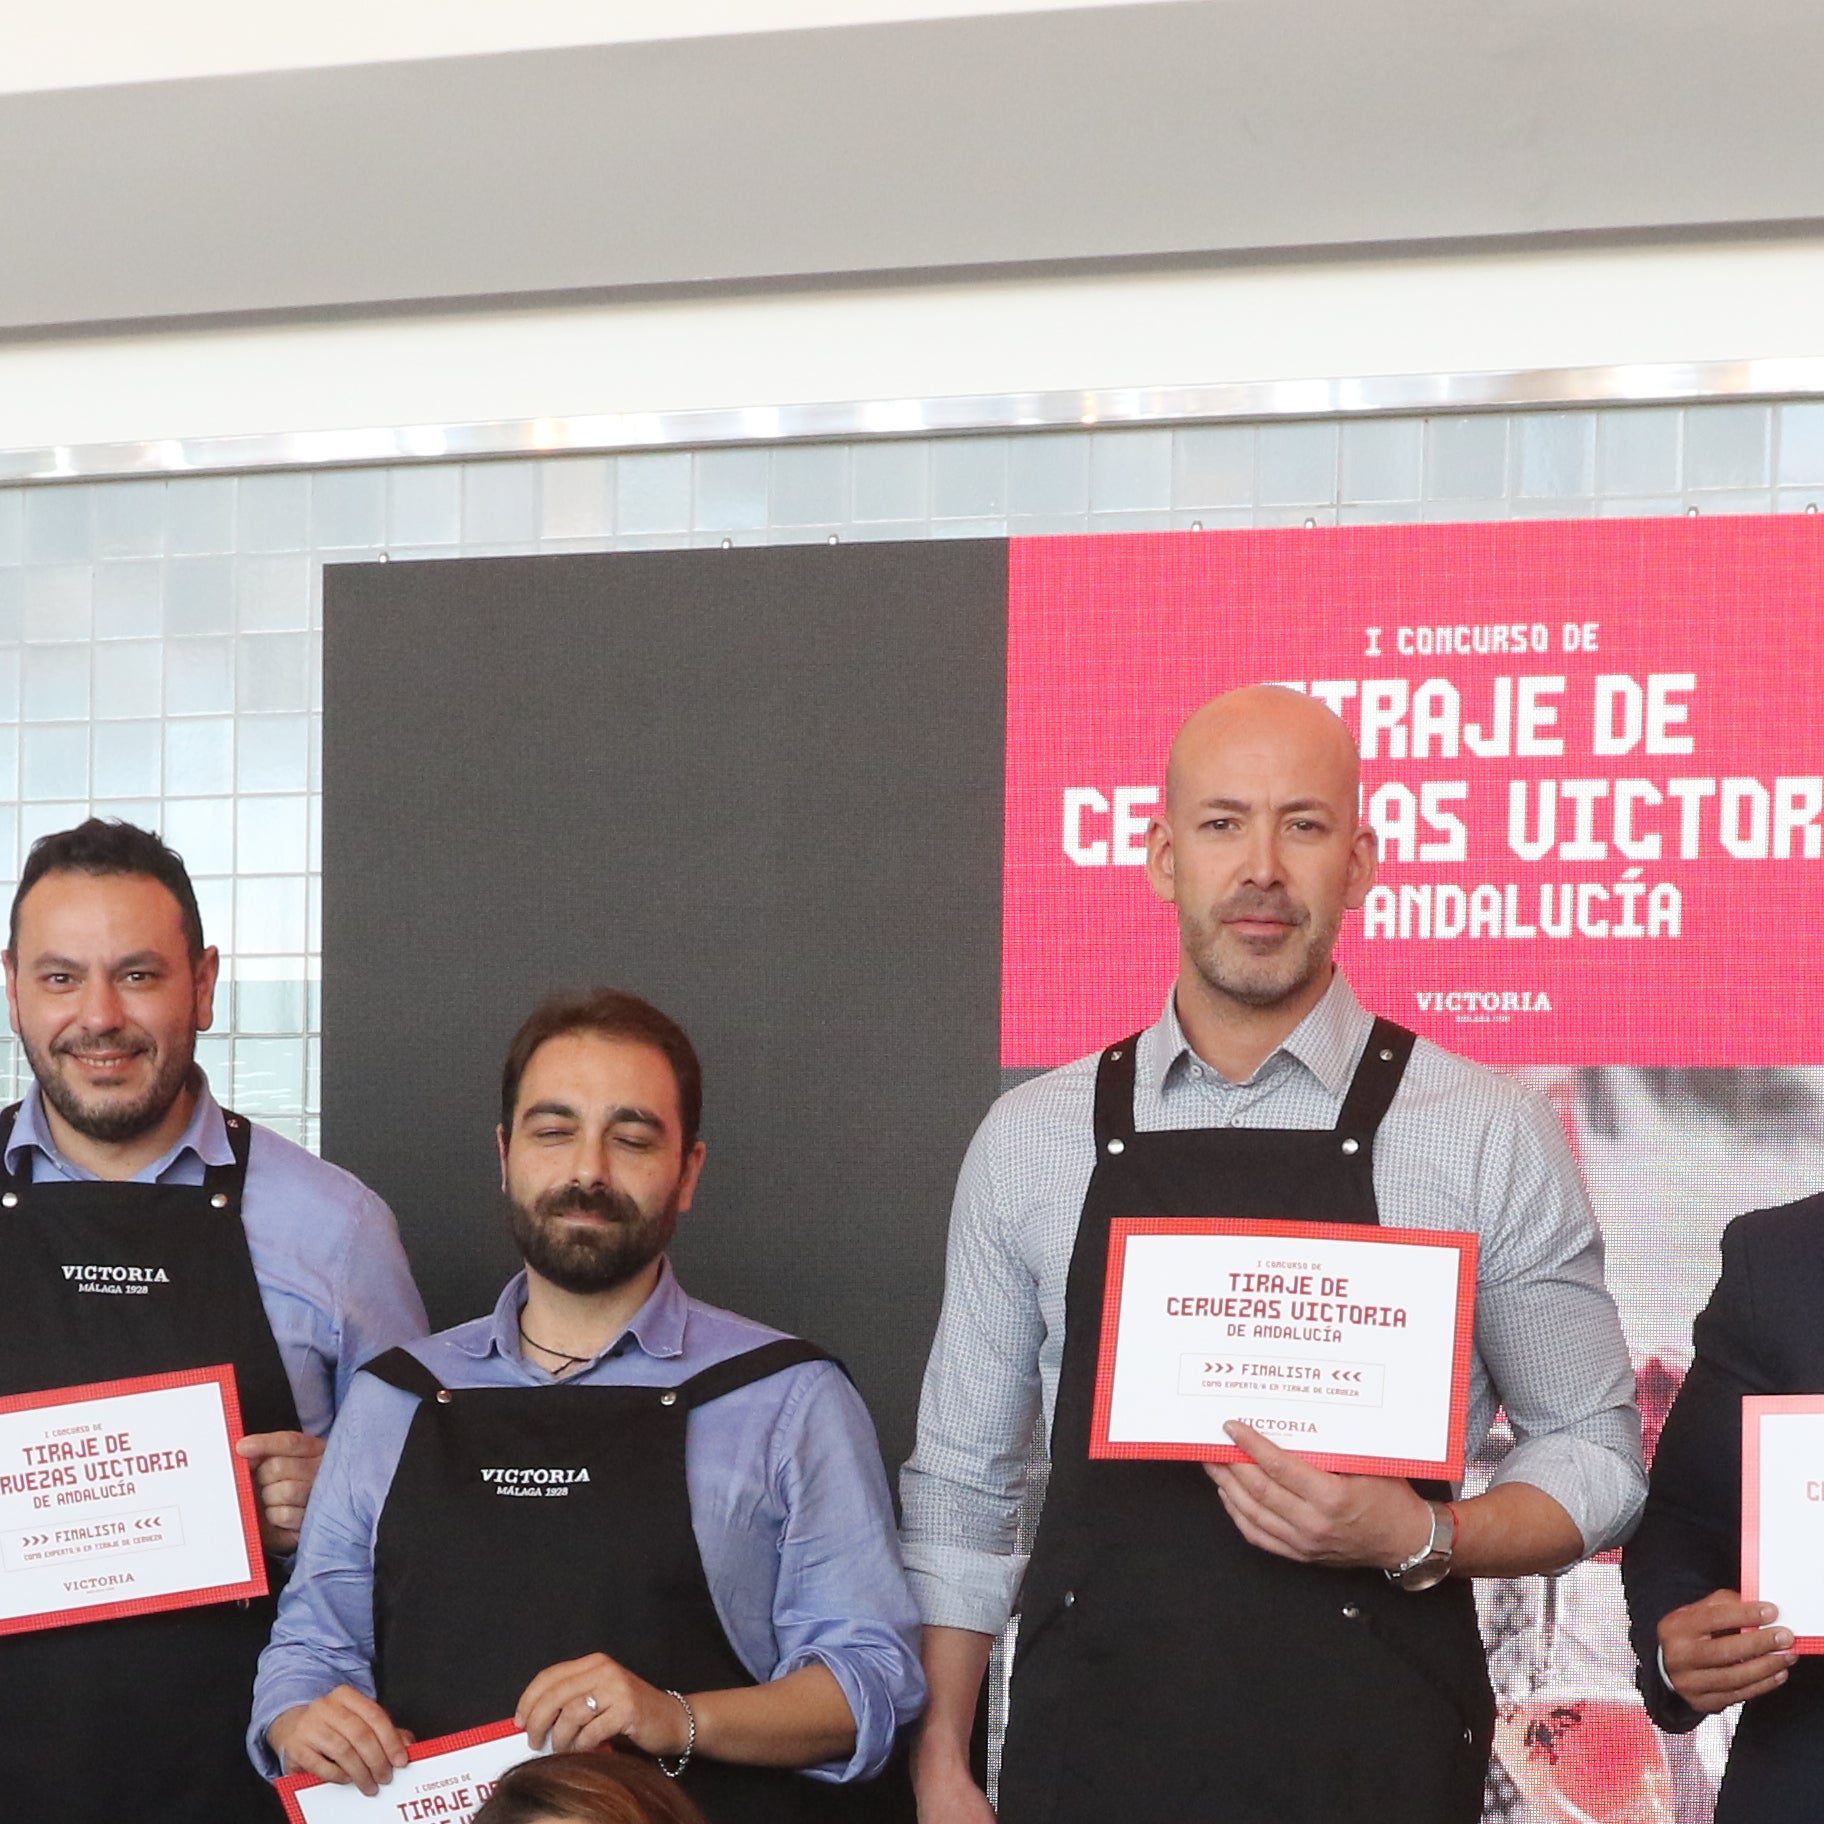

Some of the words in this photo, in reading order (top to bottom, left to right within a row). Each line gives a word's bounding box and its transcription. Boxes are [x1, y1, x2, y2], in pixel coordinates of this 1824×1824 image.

[1366, 628, 1381, 656] I
[1397, 625, 1548, 655] CONCURSO
[1561, 623, 1599, 653] DE
[1259, 675, 1564, 760] RAJE
[1594, 673, 1695, 756] DE
[1364, 867, 1681, 940] ANDALUCÍA
[1416, 992, 1553, 1011] VICTORIA
[61, 1266, 169, 1283] VICTORIA
[1227, 1272, 1313, 1295] TIRAJE
[1320, 1277, 1349, 1297] DE
[79, 1282, 122, 1294] MÁLAGA
[125, 1285, 148, 1294] 1928
[1166, 1295, 1281, 1319] CERVEZAS
[1290, 1301, 1407, 1326] VICTORIA
[1227, 1323, 1246, 1337] DE
[1253, 1325, 1342, 1342] ANDALUCÍA
[1241, 1364, 1321, 1379] FINALISTA
[22, 1437, 99, 1466] TIRAJE
[104, 1432, 132, 1453] DE
[84, 1448, 189, 1482] VICTORIA
[481, 1468, 590, 1483] VICTORIA
[33, 1494, 51, 1509] DE
[56, 1479, 136, 1505] ANDALUCÍA
[497, 1486, 542, 1496] MÁLAGA
[545, 1487, 568, 1496] 1928
[54, 1522, 126, 1542] FINALISTA
[63, 1572, 135, 1592] VICTORIA
[397, 1789, 473, 1822] TIRAJE
